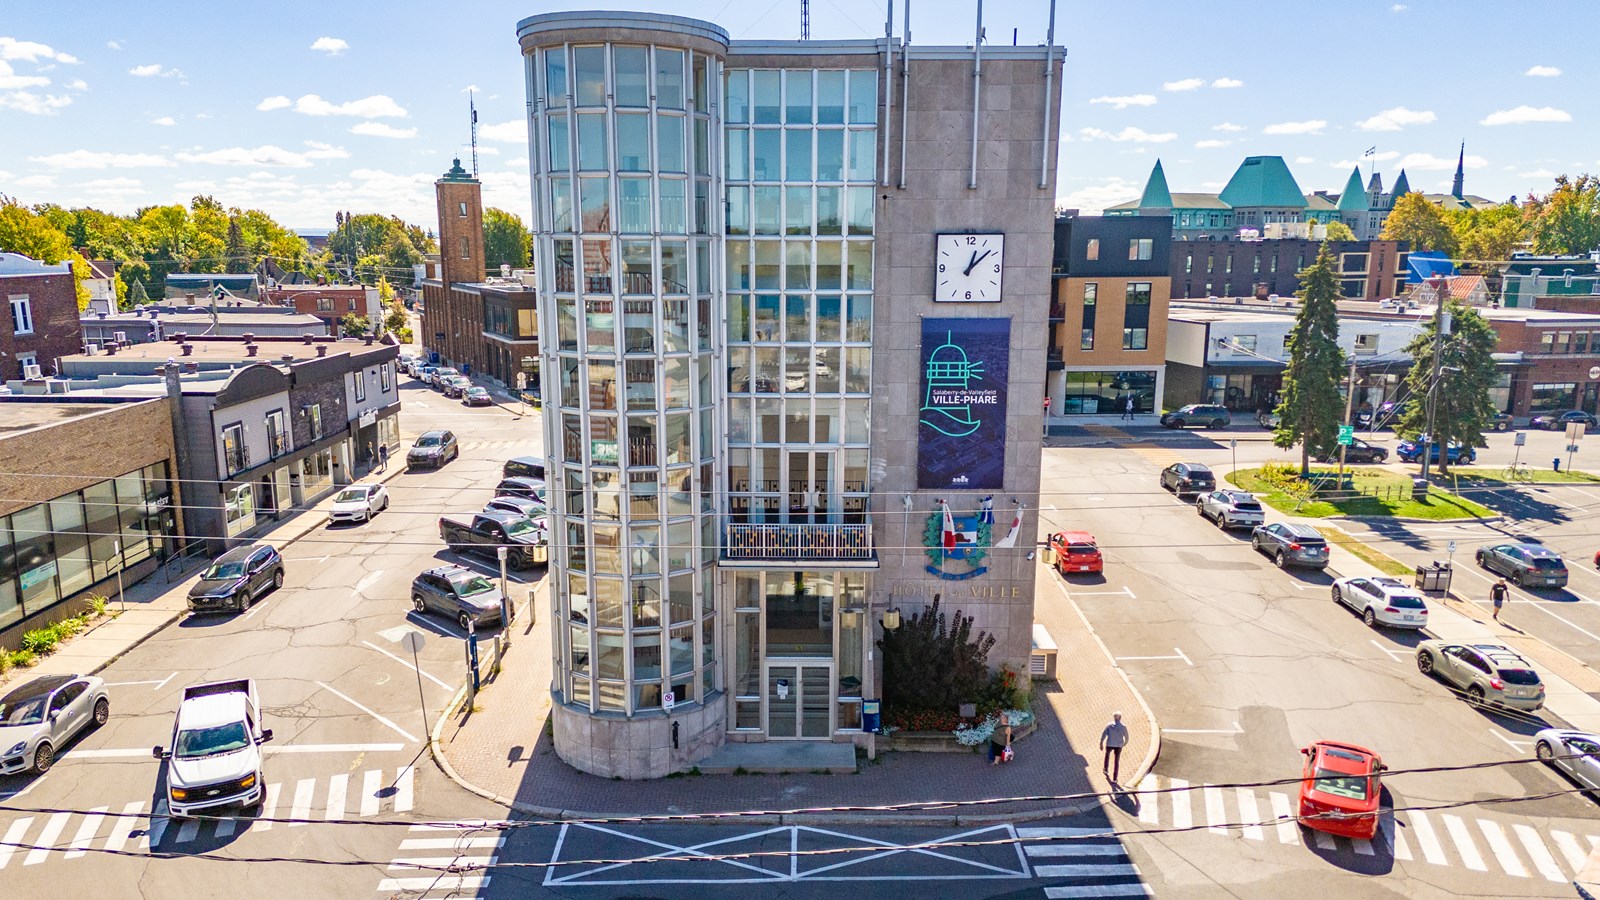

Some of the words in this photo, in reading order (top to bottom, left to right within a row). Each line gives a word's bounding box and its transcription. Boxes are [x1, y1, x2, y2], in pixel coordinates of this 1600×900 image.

[966, 236, 976, 245] 12
[939, 264, 945, 273] 9
[994, 264, 1000, 273] 3
[965, 291, 971, 299] 6
[933, 395, 997, 404] VILLE-PHARE
[971, 586, 1020, 598] VILLE
